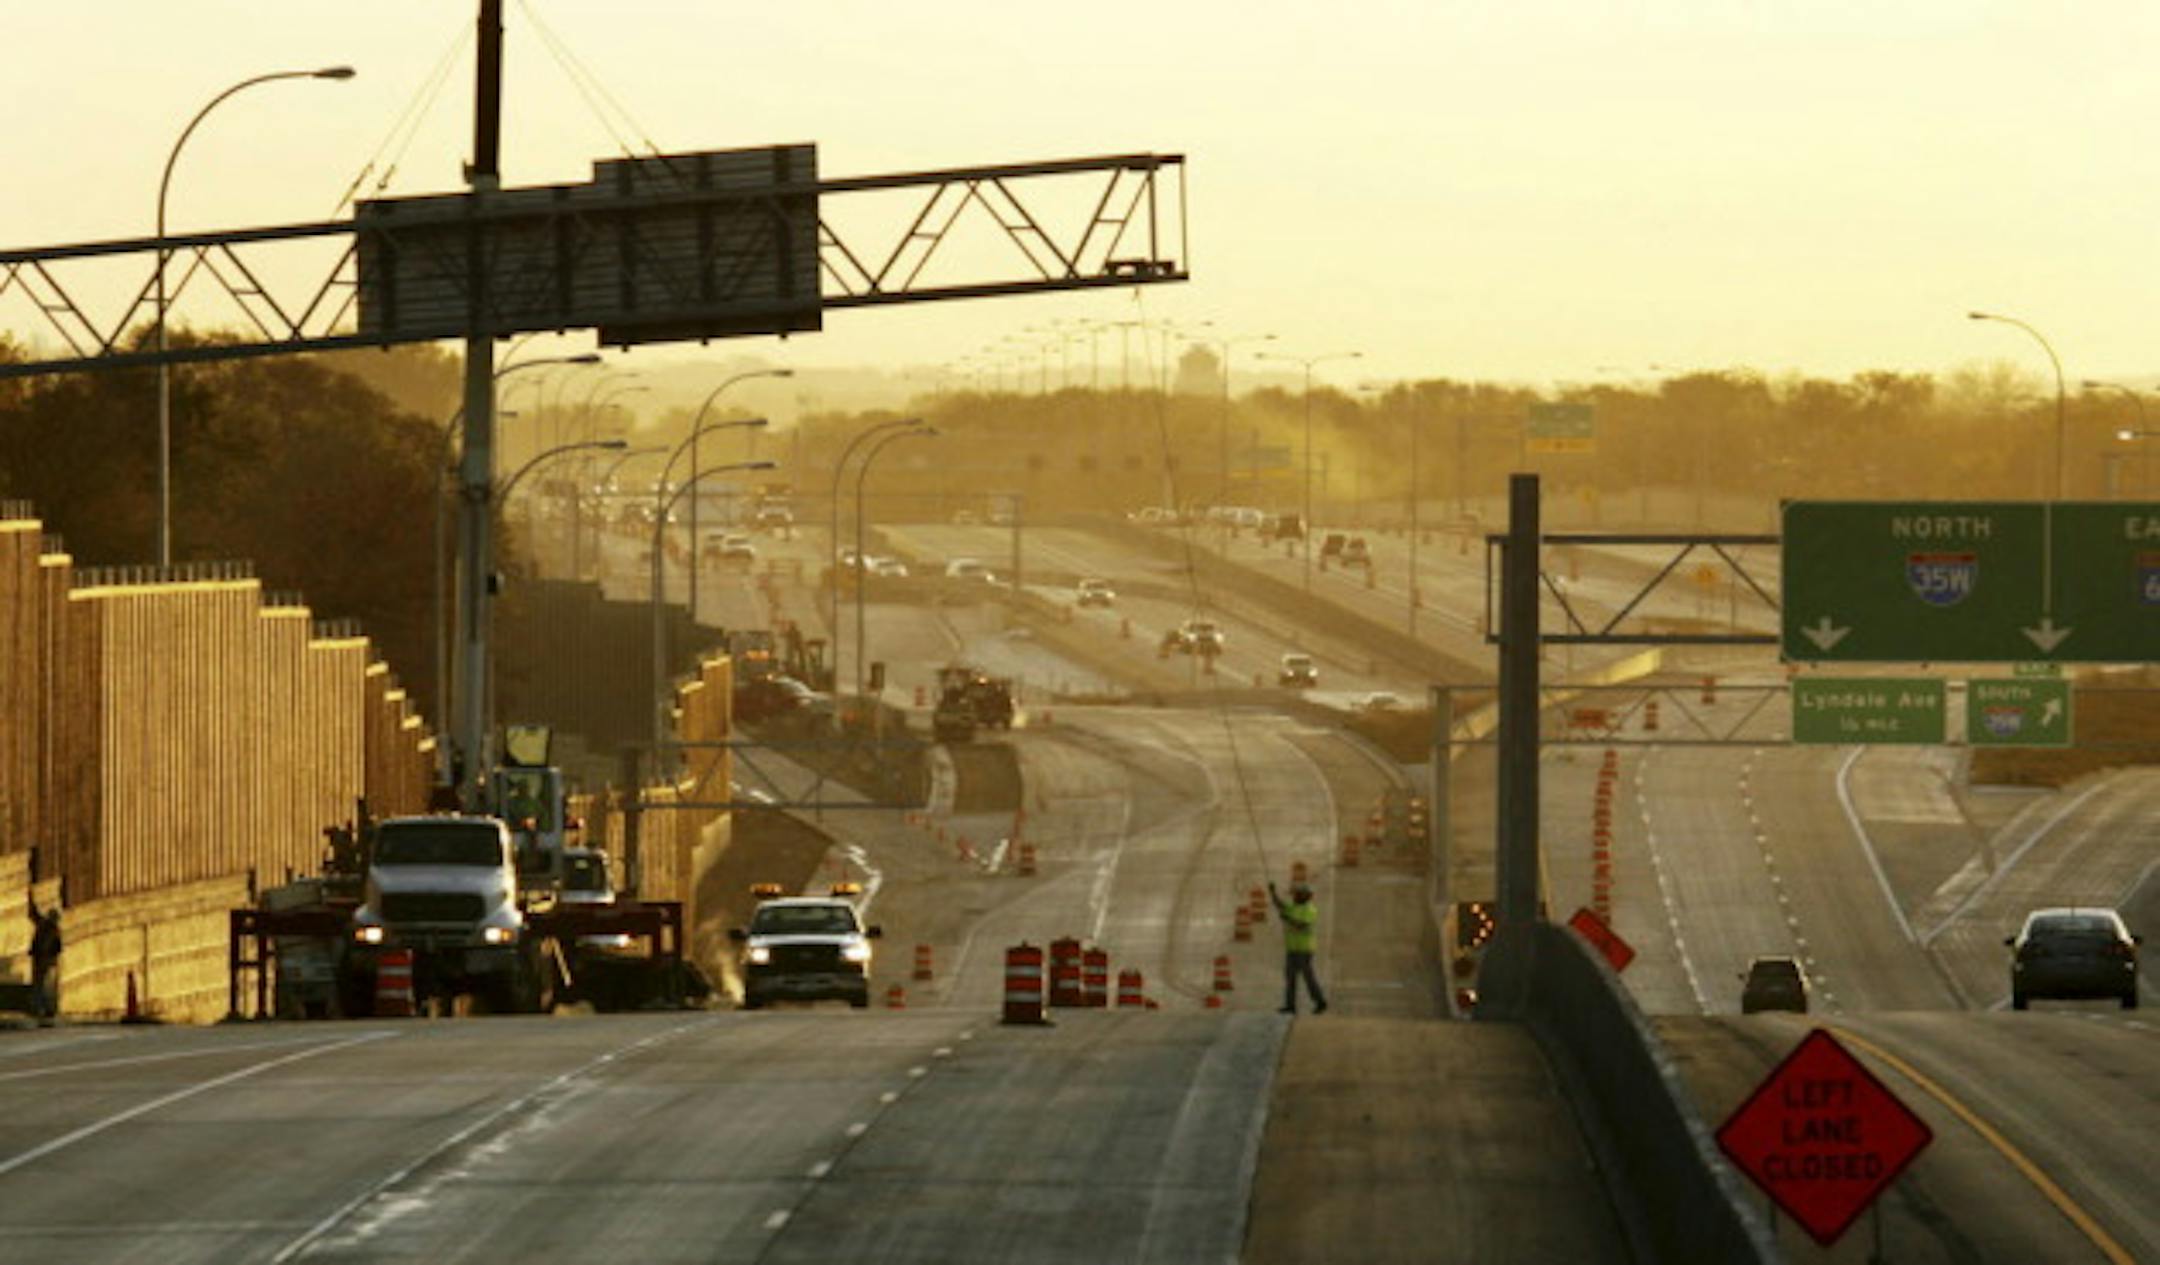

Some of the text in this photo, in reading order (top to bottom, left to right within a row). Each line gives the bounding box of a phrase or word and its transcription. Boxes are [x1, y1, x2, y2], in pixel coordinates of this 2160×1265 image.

[1892, 517, 1992, 538] NORTH
[1913, 566, 1970, 594] 35W
[1801, 691, 1936, 711] Lyndale Ave
[1977, 685, 2031, 701] SOUTH
[1784, 1080, 1853, 1108] LEFT
[1782, 1118, 1860, 1145] LANE
[1763, 1152, 1882, 1180] CLOSED
